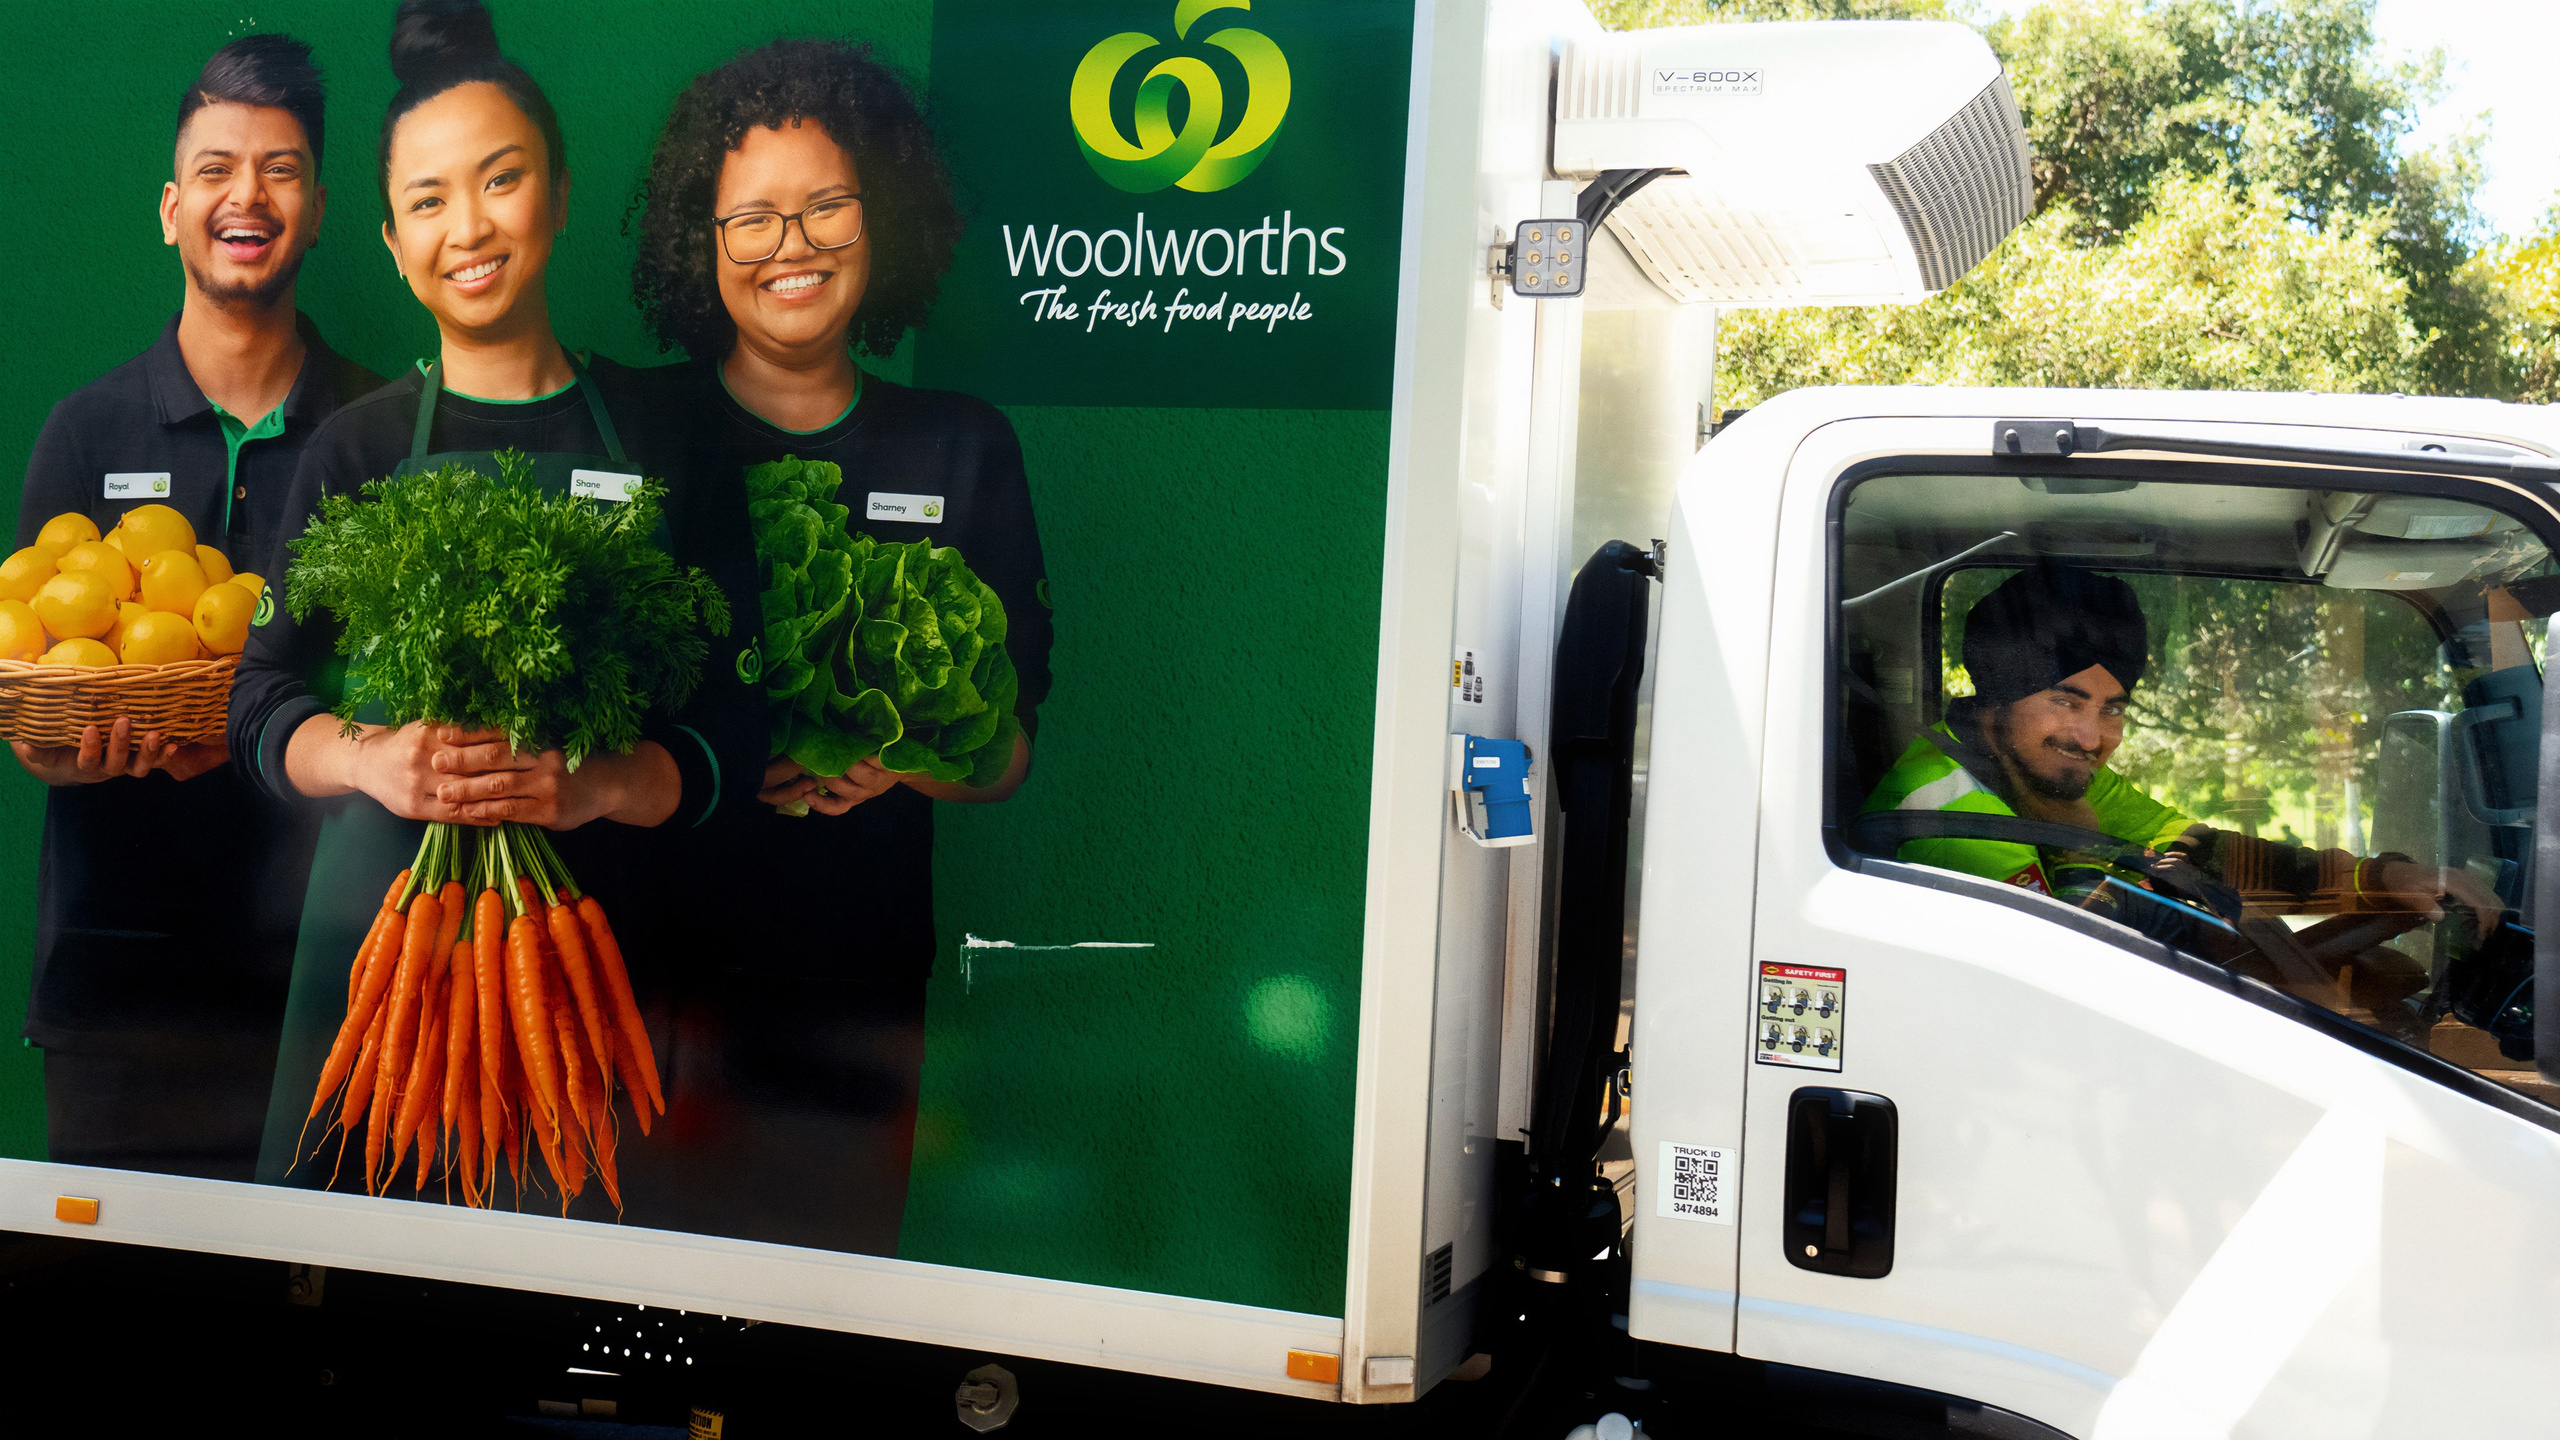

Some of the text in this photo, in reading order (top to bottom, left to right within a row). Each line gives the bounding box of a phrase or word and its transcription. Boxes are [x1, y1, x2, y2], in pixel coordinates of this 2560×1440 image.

[1658, 71, 1758, 82] V-600X
[1003, 210, 1347, 277] Woolworths
[1020, 284, 1313, 333] The fresh food people
[108, 482, 130, 492] Royal
[575, 478, 601, 489] Shane
[871, 501, 907, 514] Sharney
[1785, 968, 1813, 976] SAFETY
[1814, 971, 1837, 979] FIRST
[1763, 977, 1785, 985] Getting
[1673, 1146, 1722, 1158] TRUCK ID
[1673, 1202, 1719, 1217] 3474894
